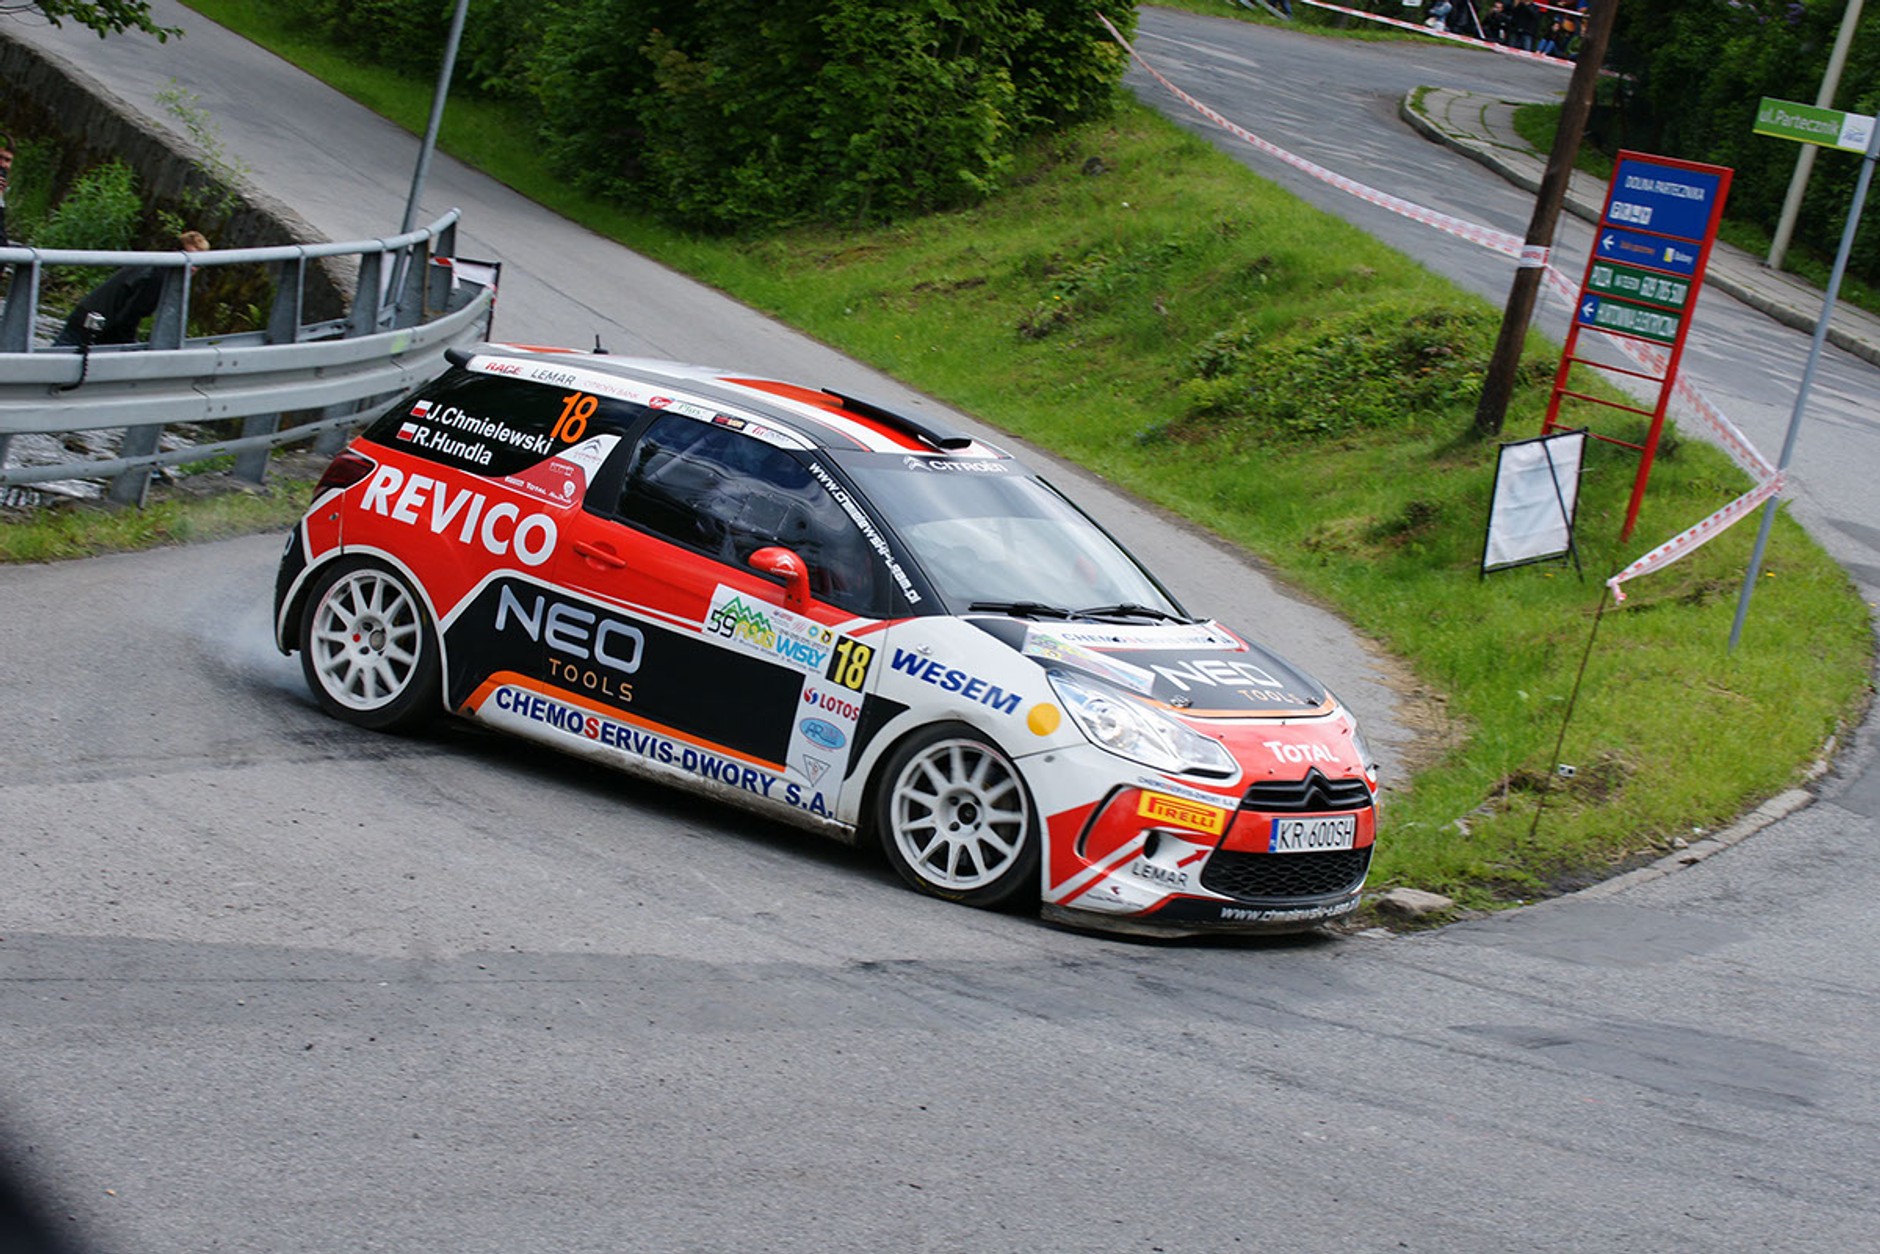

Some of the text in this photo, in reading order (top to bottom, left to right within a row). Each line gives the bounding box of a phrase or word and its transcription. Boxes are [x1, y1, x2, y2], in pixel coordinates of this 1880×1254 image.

[531, 368, 577, 386] LEMAR
[426, 401, 552, 455] J.Chmielewski
[551, 392, 598, 443] 18
[412, 425, 492, 466] R.Hundla
[360, 464, 558, 567] REVICO
[494, 584, 645, 674] NEO
[707, 609, 737, 638] 59
[549, 657, 633, 702] TOOLS
[833, 639, 871, 690] 18
[891, 648, 1022, 715] WESEM
[1151, 659, 1283, 691] NEO
[820, 693, 860, 721] LOTOS
[1237, 689, 1304, 706] TOOLS
[496, 687, 834, 818] CHEMOSERVIS-DWORY S.A.
[1263, 741, 1341, 764] TOTAL
[1147, 796, 1217, 828] PIRELLI
[1279, 819, 1354, 849] KR 600SH
[1131, 861, 1189, 887] LEMAR
